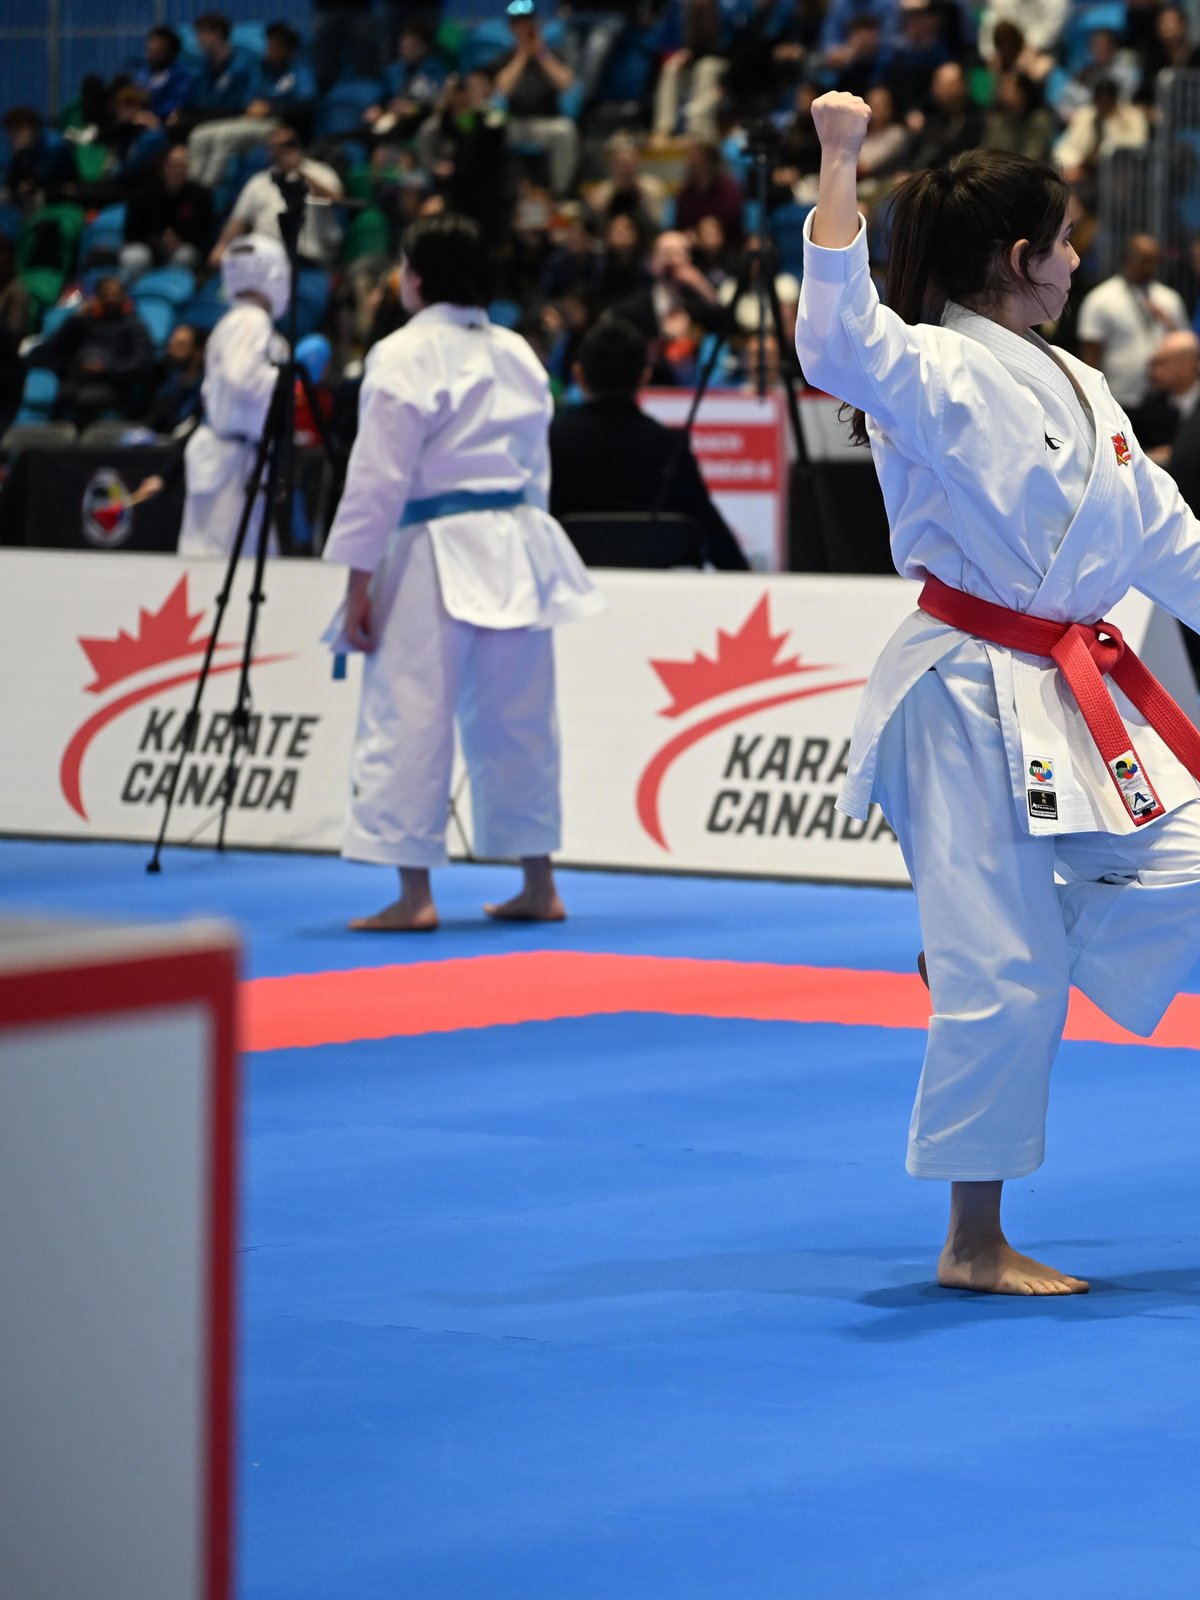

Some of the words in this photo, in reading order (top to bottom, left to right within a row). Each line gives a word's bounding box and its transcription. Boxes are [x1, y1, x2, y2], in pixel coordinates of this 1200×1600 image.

[139, 707, 320, 759] KARATE
[723, 733, 851, 784] KARA
[121, 760, 299, 811] CANADA
